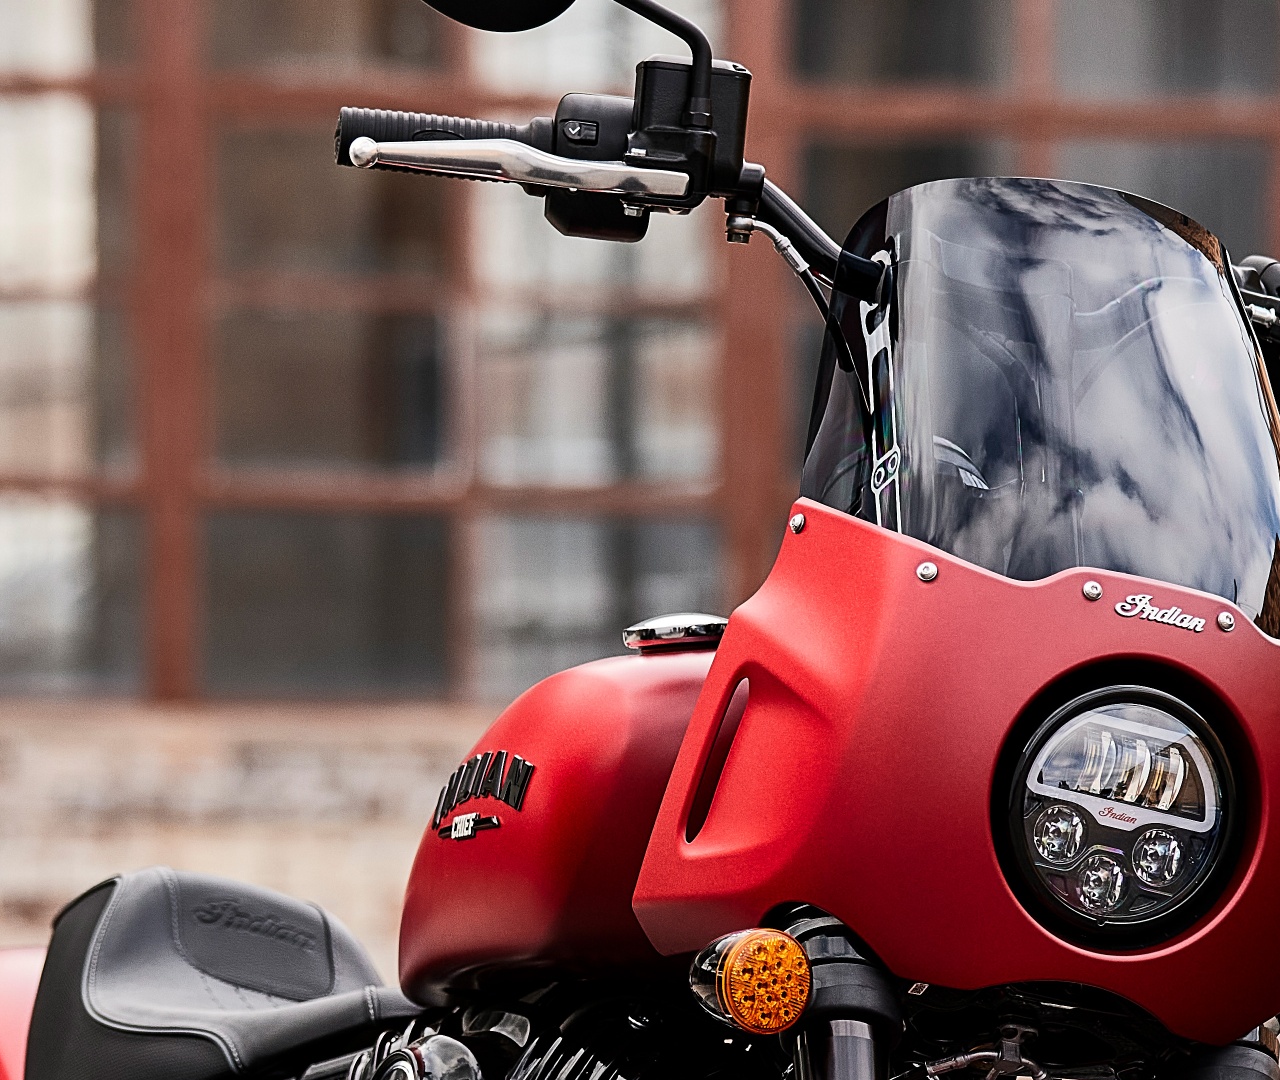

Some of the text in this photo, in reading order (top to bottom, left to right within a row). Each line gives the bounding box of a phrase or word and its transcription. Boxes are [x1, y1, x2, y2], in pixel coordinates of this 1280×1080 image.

[1114, 593, 1206, 632] Indian
[432, 750, 535, 830] INDIAN
[451, 813, 478, 839] CHIEF
[1099, 806, 1137, 825] Indian
[192, 900, 317, 951] Indian
